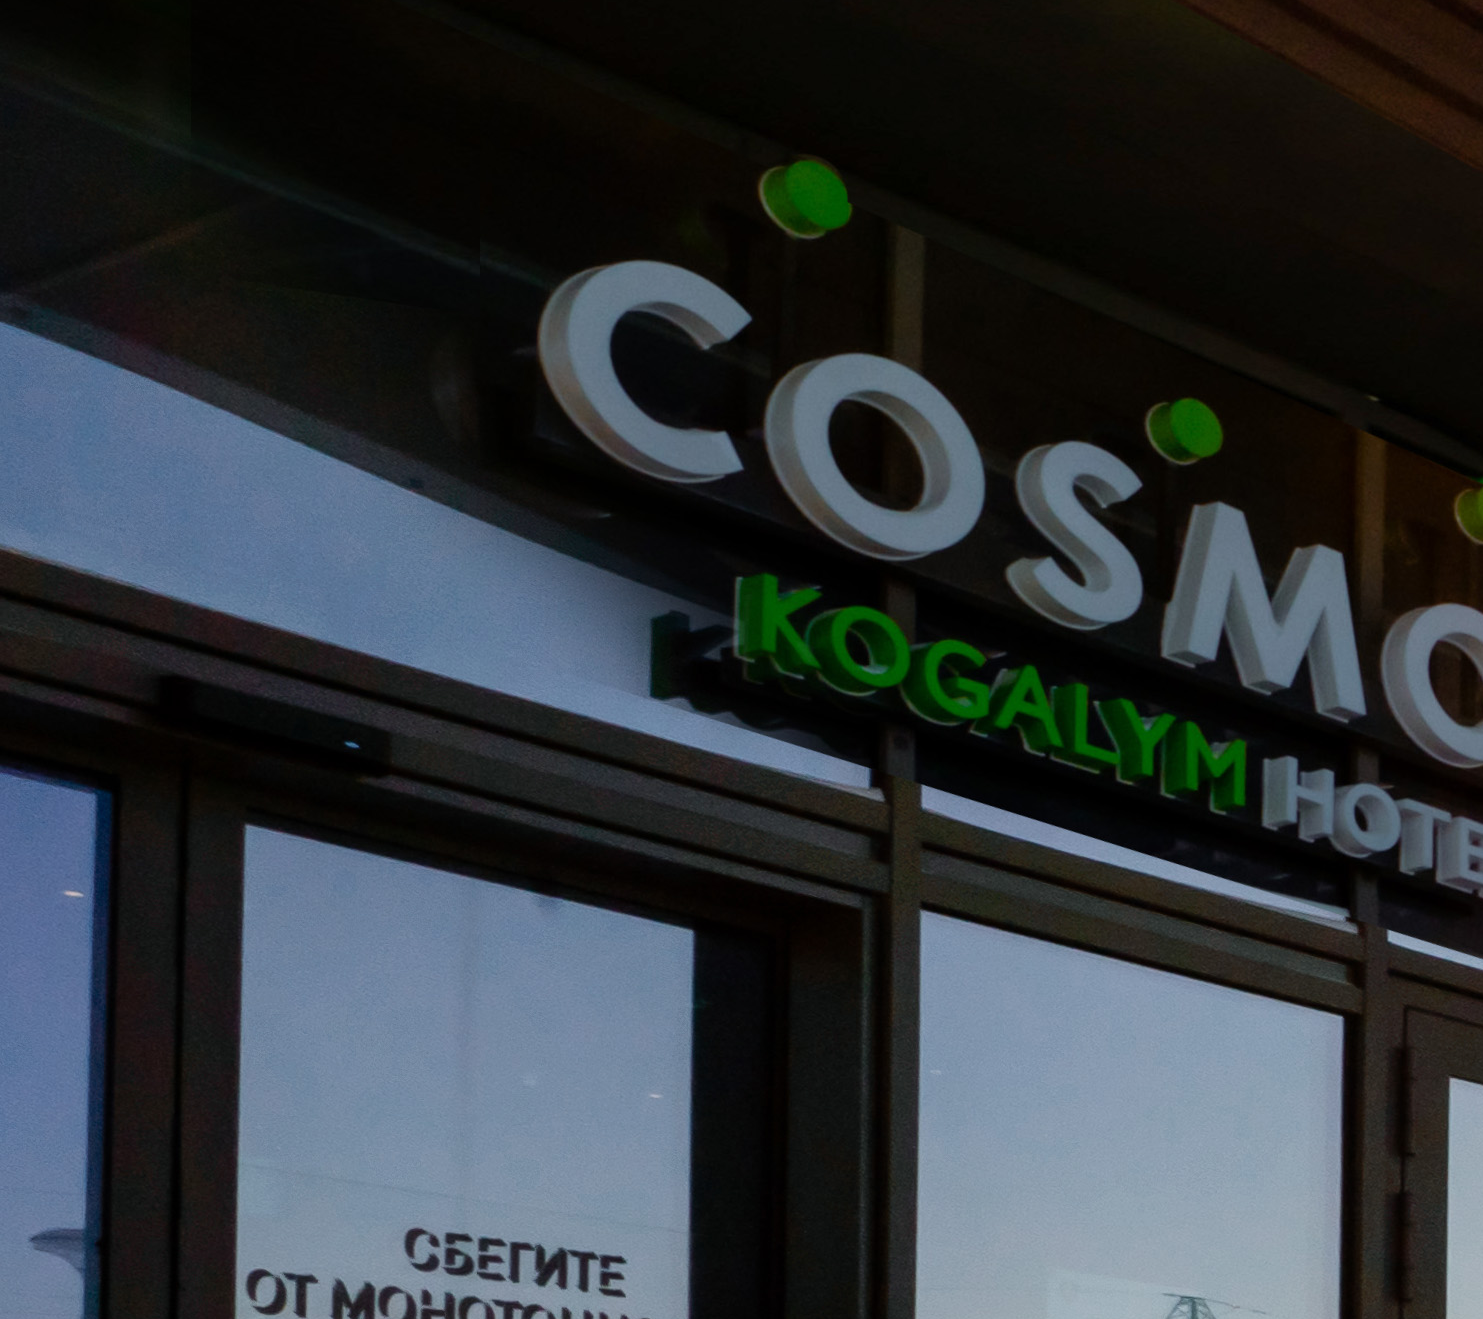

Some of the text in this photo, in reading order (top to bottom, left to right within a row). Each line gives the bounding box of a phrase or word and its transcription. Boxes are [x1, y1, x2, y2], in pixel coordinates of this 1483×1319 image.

[733, 573, 1248, 815] KOGALYM
[245, 1268, 319, 1319] ОТ
[404, 1227, 628, 1298] СБЕГИТЕ
